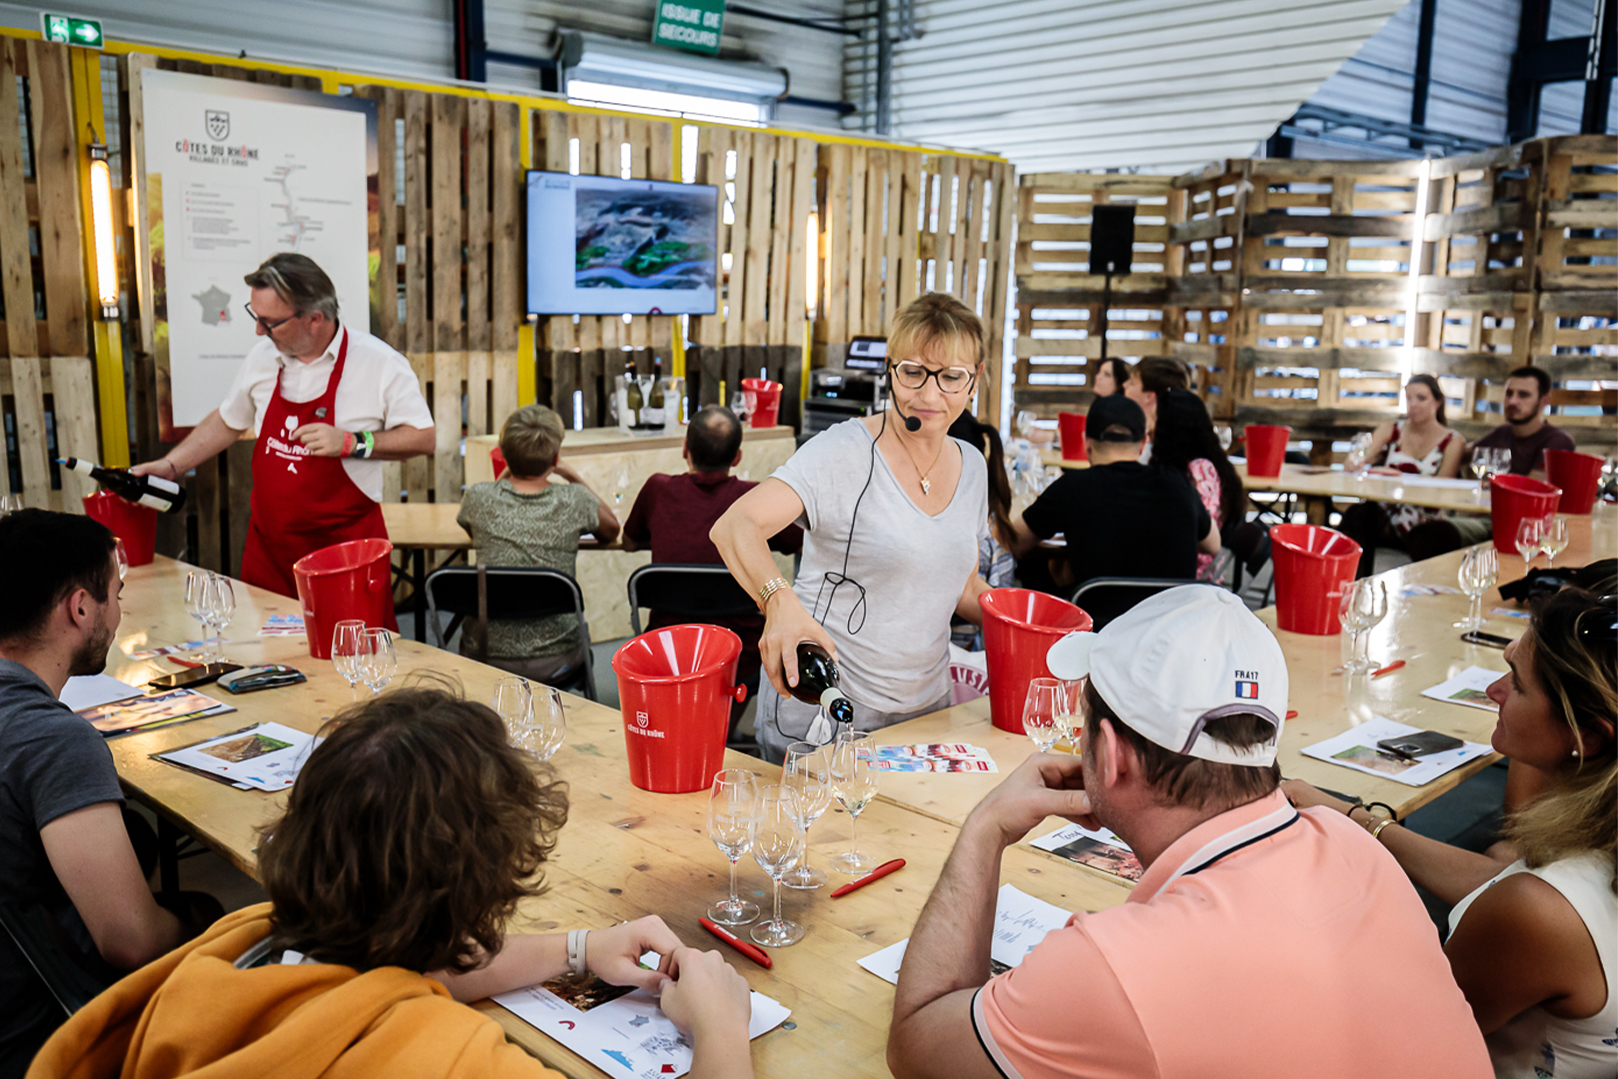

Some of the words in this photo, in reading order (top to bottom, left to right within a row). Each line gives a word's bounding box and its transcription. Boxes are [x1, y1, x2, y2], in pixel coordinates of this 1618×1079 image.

[661, 3, 701, 25] ISSUE
[703, 11, 721, 29] DE
[658, 22, 717, 48] SECOURS
[175, 138, 208, 155] CÔTES
[211, 144, 224, 156] DU
[227, 144, 259, 160] RHÔNE
[1235, 669, 1259, 680] FRA17
